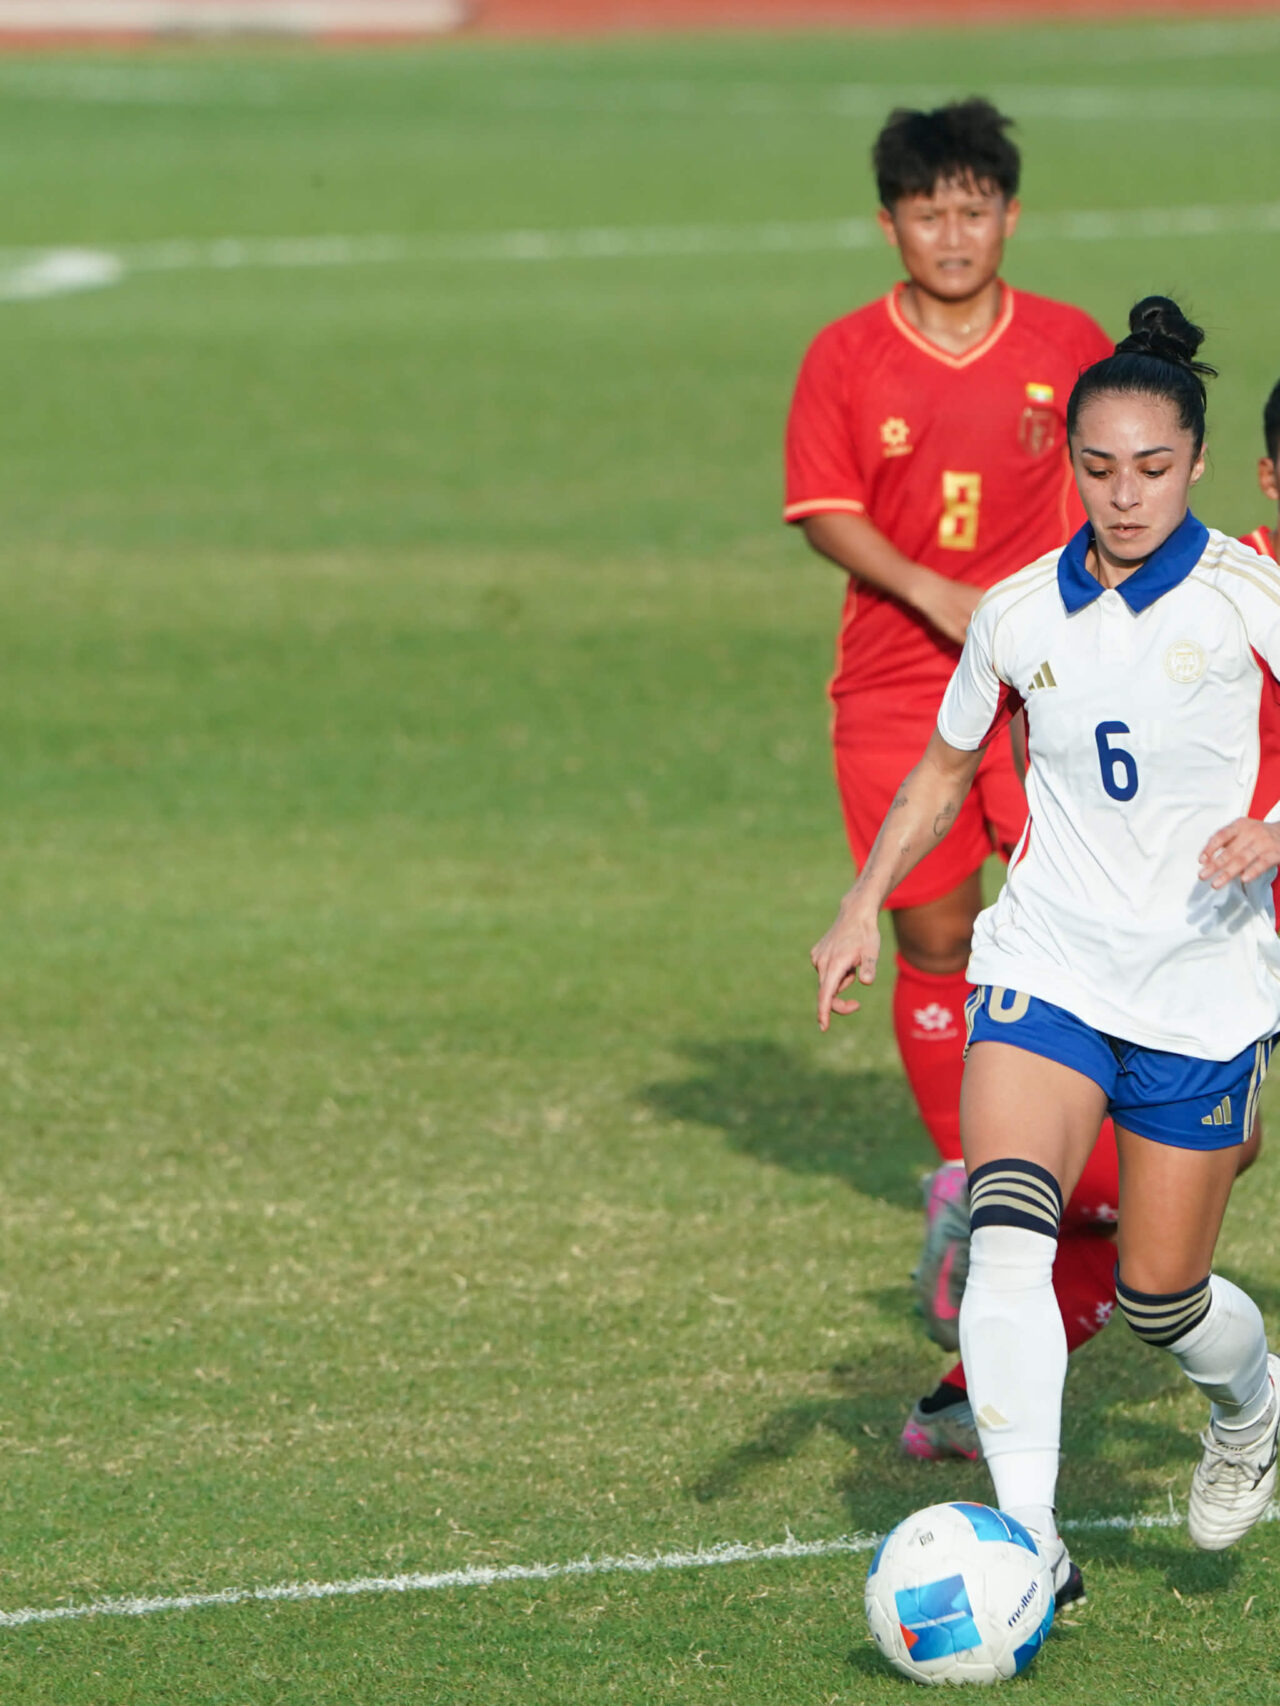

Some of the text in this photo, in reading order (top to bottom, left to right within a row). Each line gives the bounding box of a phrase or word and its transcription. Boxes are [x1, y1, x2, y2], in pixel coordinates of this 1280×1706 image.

[939, 470, 981, 551] 8
[1095, 720, 1139, 802] 6
[1007, 1580, 1039, 1628] molten
